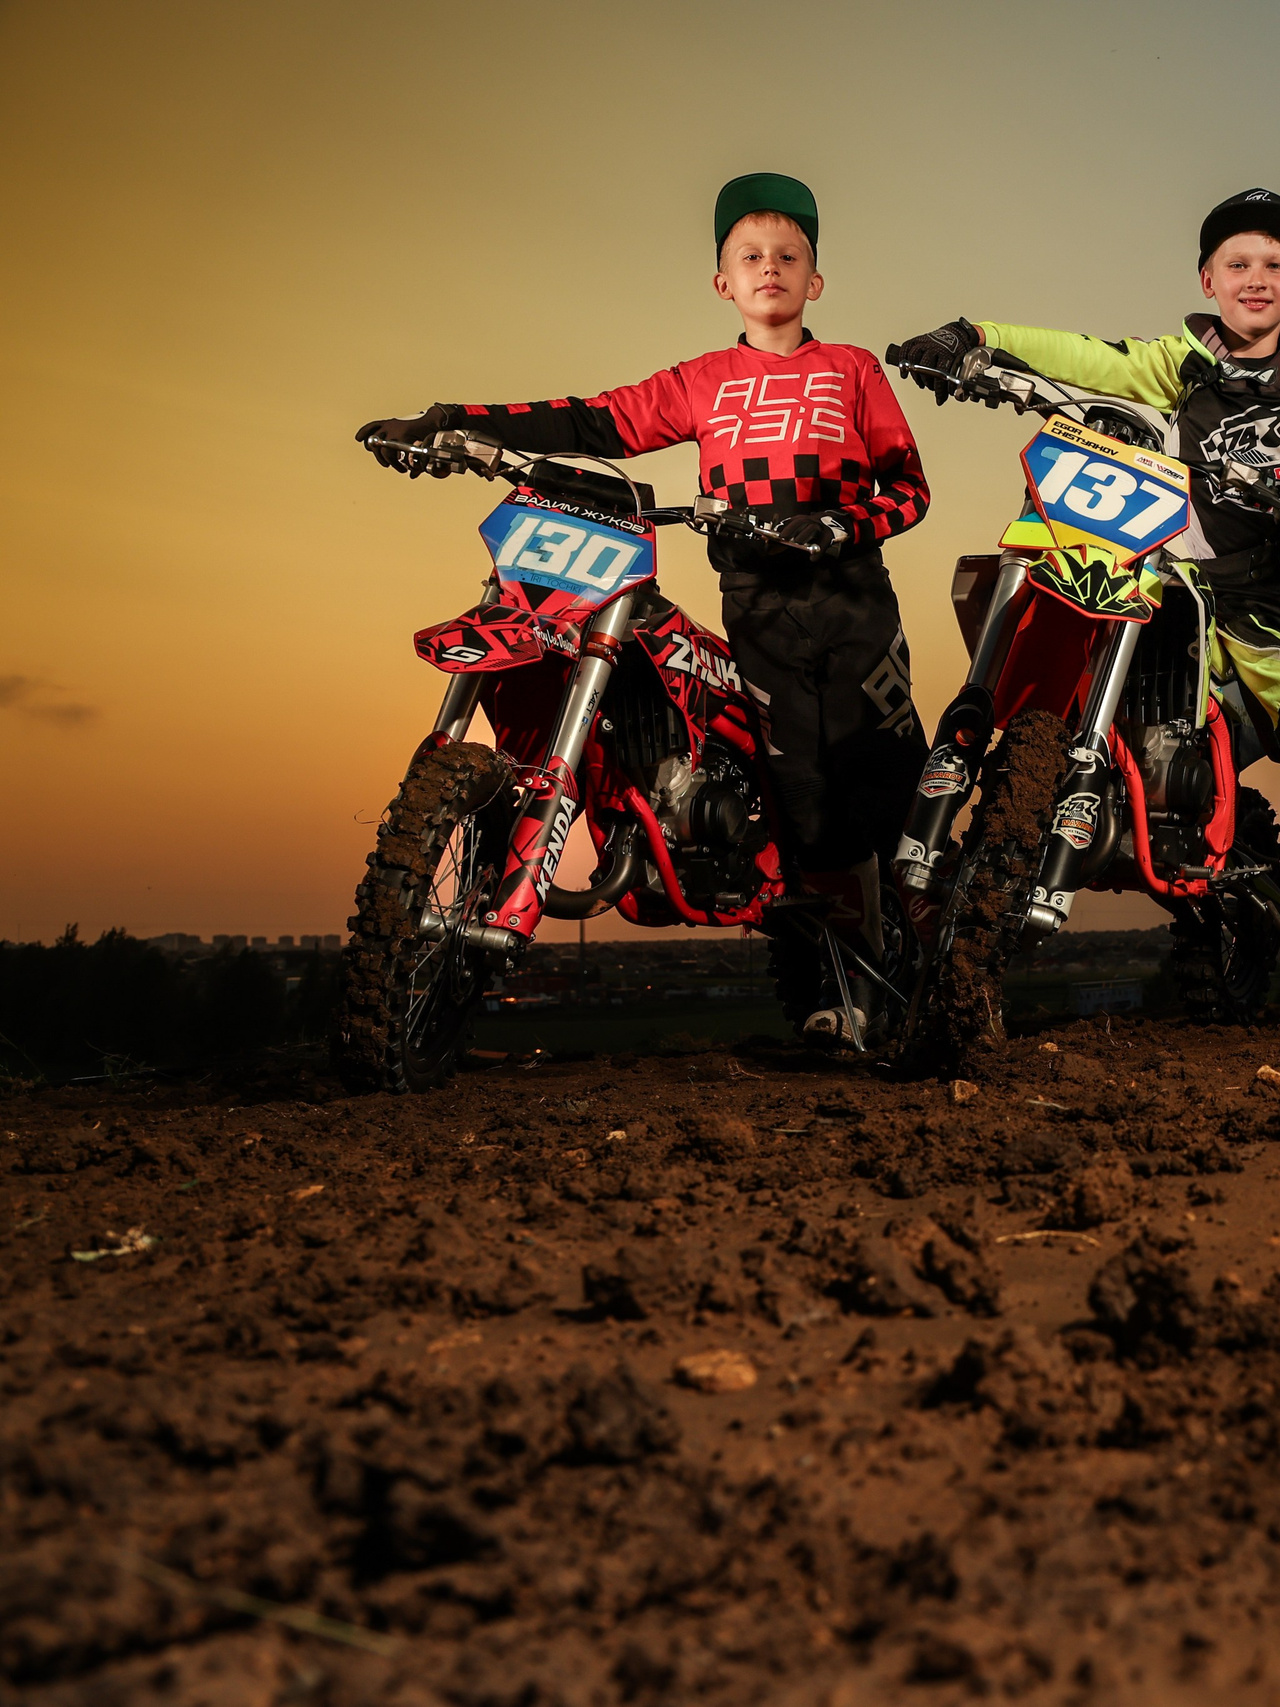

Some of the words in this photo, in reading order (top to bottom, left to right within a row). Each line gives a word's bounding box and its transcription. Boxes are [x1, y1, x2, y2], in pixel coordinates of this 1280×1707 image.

[1053, 420, 1083, 436] EGOR
[514, 494, 579, 514] ВАДИМ
[581, 508, 646, 534] ЖУКОВ
[1037, 450, 1187, 541] 137
[495, 517, 639, 591] 130
[666, 632, 742, 692] ZHUK
[536, 795, 577, 903] KENDA
